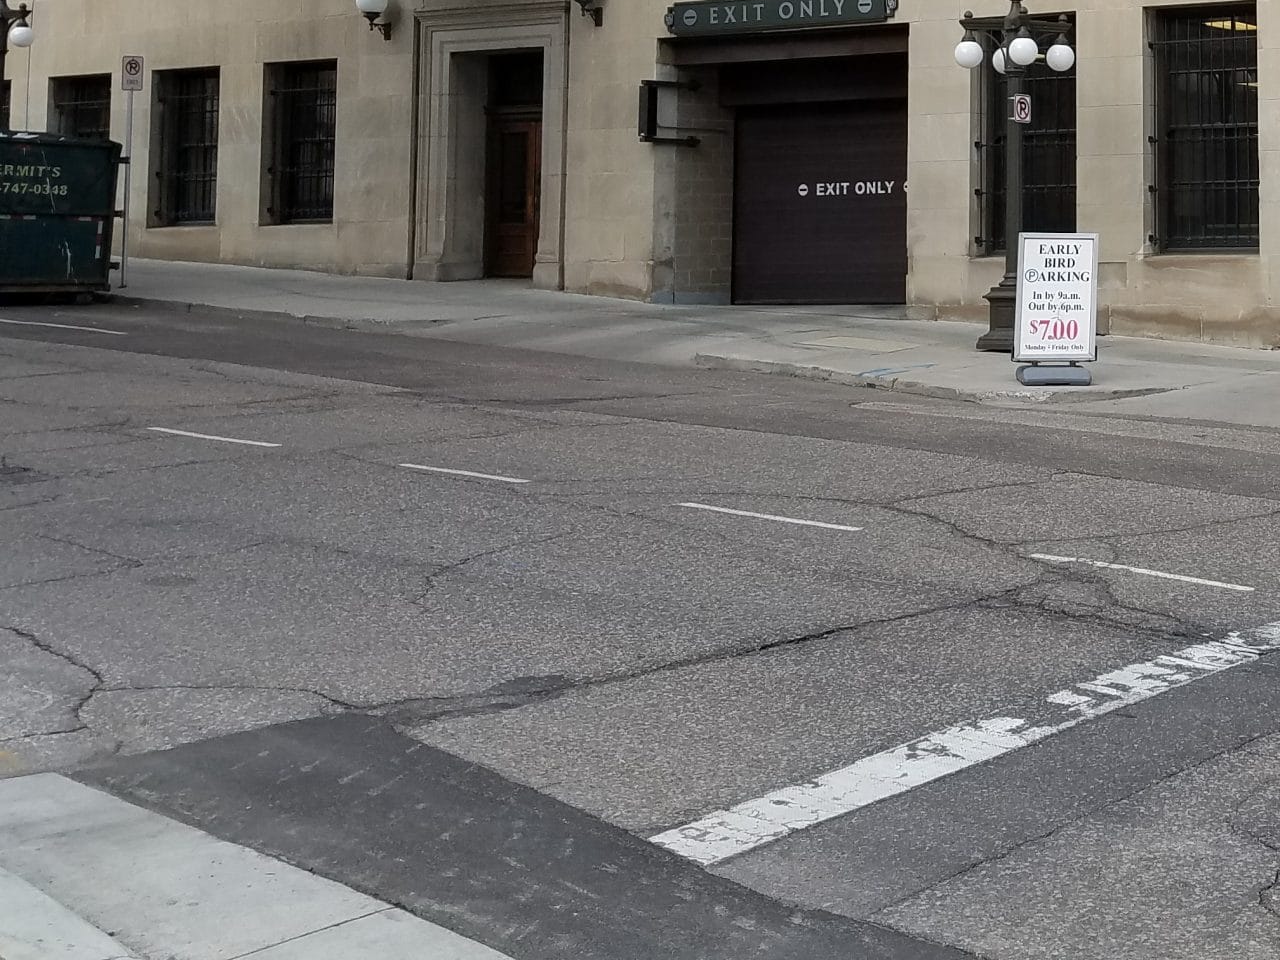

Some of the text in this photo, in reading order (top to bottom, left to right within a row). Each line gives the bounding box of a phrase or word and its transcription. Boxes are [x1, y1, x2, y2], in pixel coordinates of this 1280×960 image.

[709, 3, 765, 25] EXIT
[0, 164, 61, 177] RMIT'S
[0, 182, 68, 196] 747-0348
[816, 181, 895, 196] EXIT ONLY
[1039, 244, 1082, 255] EARLY
[1044, 258, 1076, 268] BIRD
[1033, 291, 1081, 302] In by 9a.m.
[1028, 302, 1045, 310] Out
[1060, 302, 1084, 313] 6p.m.
[1071, 344, 1084, 352] Only
